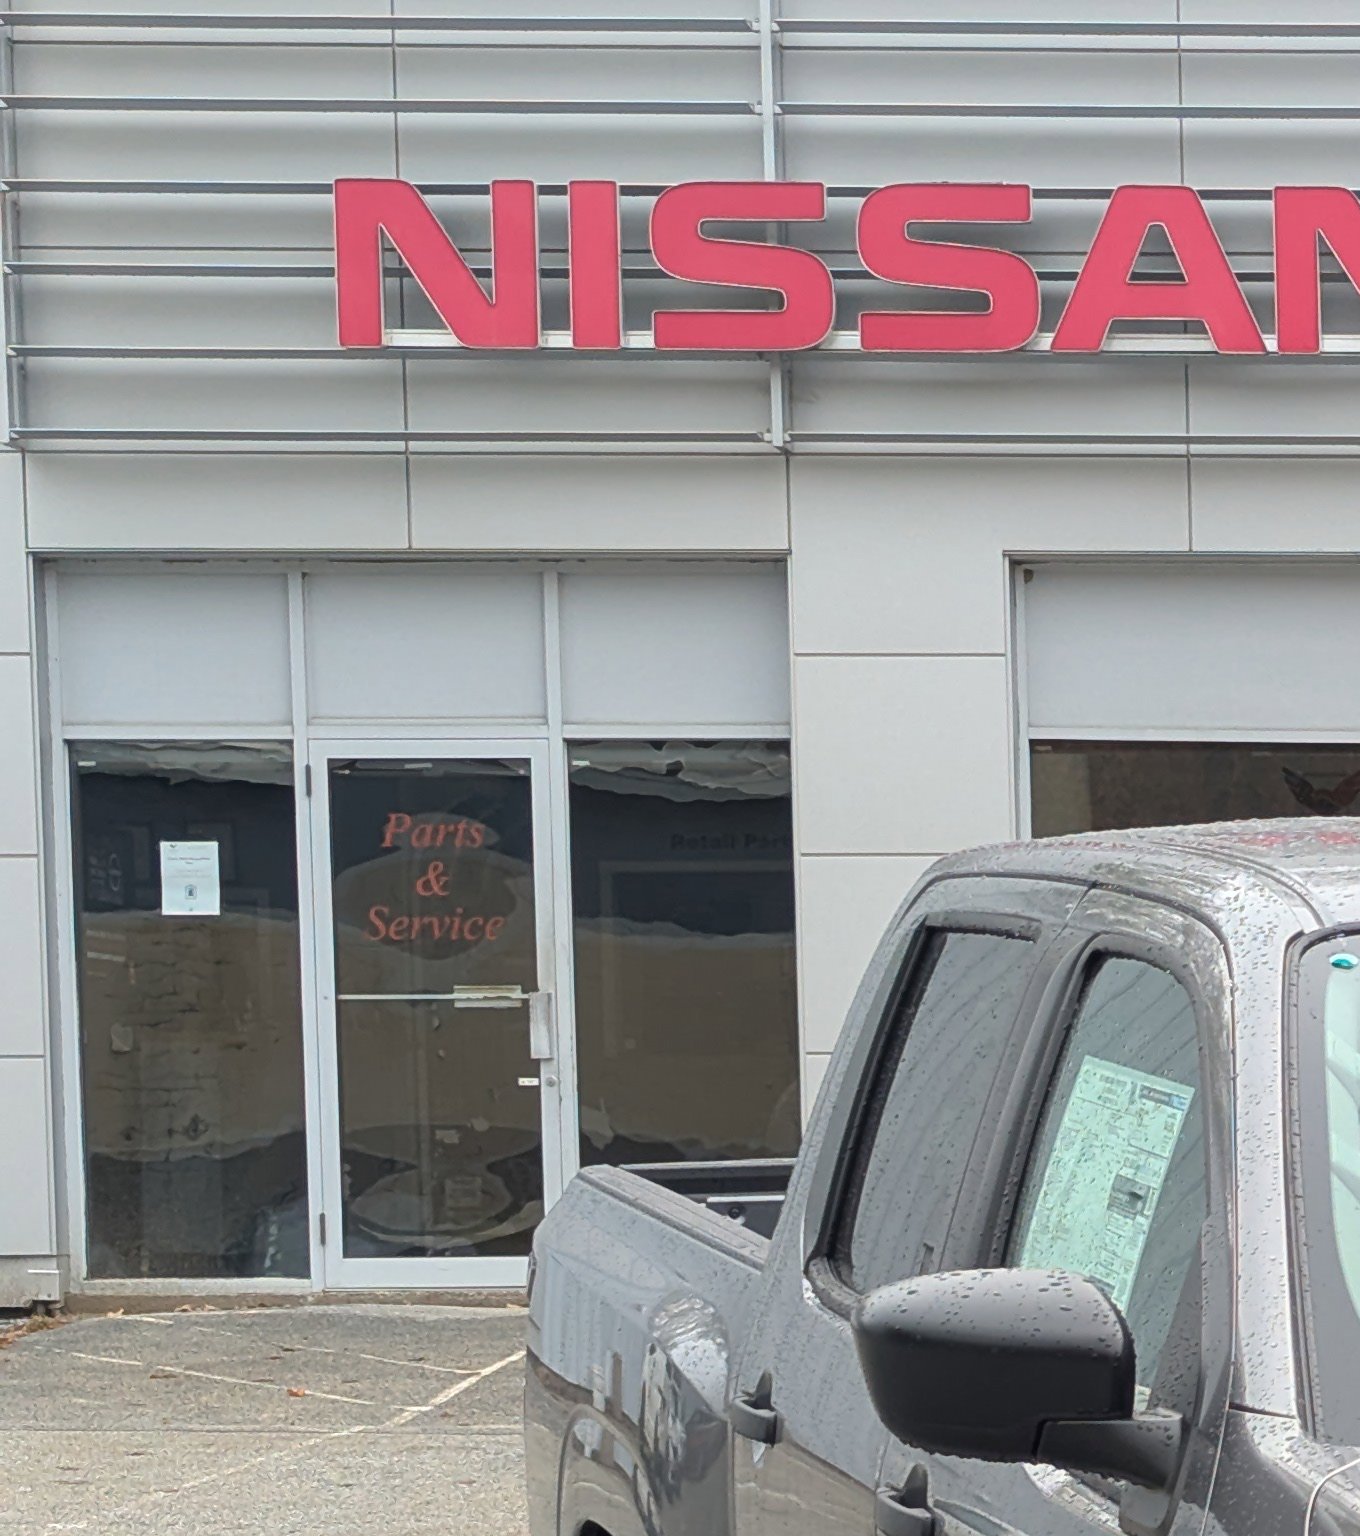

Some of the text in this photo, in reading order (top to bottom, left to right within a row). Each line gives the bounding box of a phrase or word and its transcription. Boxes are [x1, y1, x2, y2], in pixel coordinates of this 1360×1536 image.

[381, 813, 485, 848] Parts
[416, 861, 450, 896] &
[364, 905, 505, 941] Service
